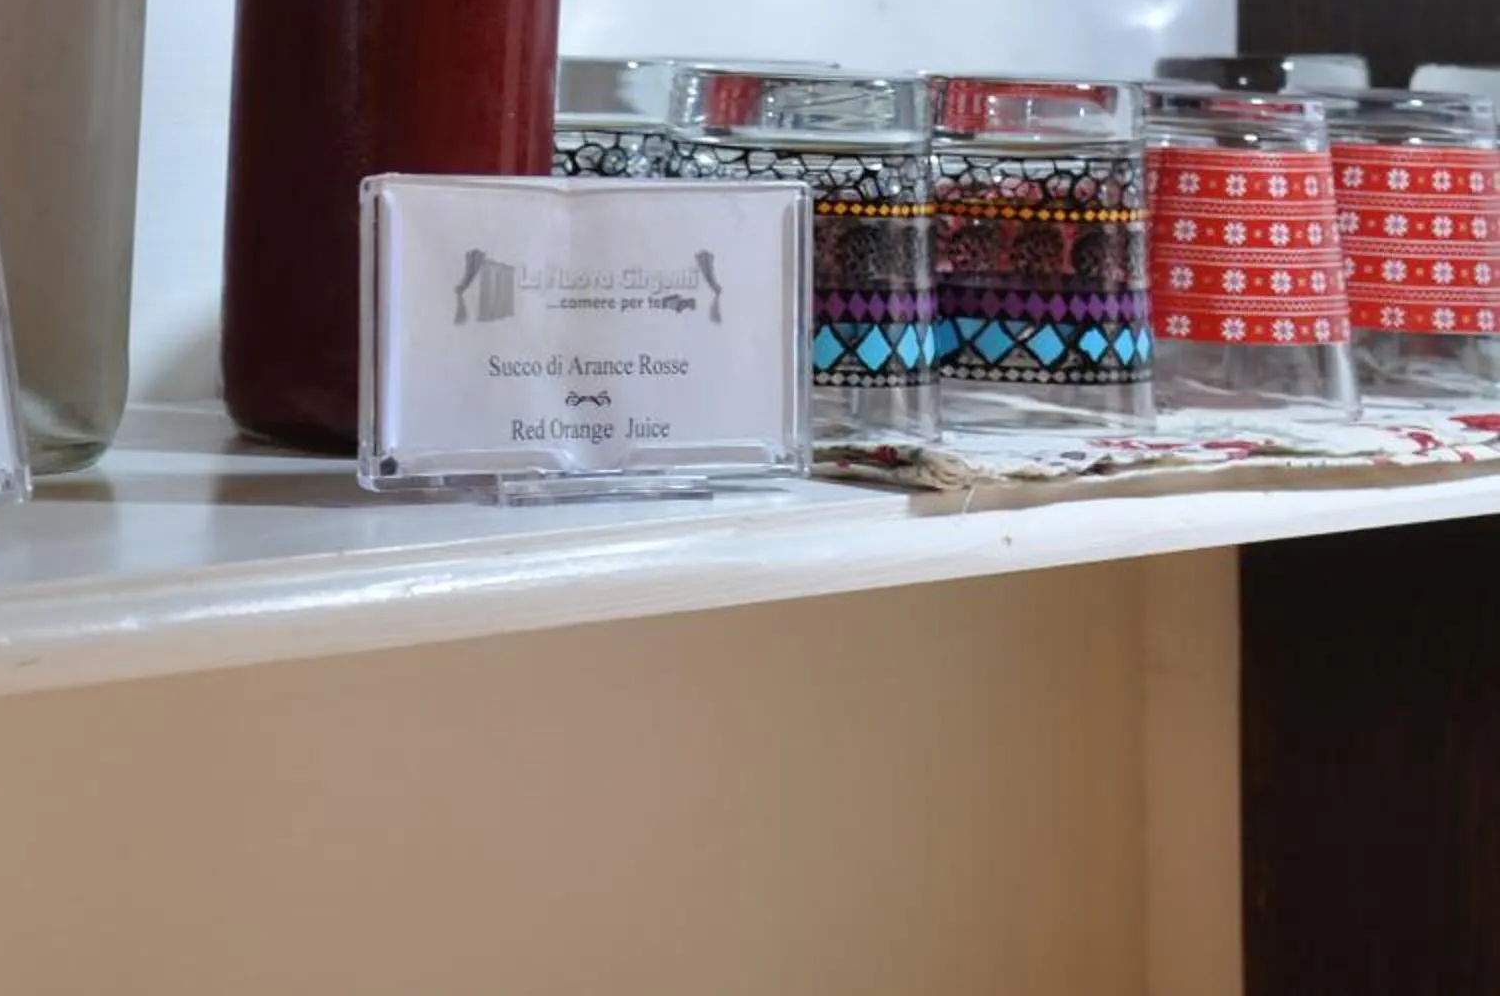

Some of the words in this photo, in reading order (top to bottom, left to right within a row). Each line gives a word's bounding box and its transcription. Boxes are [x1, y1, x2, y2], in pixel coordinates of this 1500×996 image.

[620, 297, 644, 313] per
[488, 354, 542, 378] Succo
[546, 354, 563, 376] di
[567, 355, 634, 376] Arance
[639, 353, 690, 376] Rosse
[511, 419, 545, 441] Red
[550, 418, 614, 445] Orange
[625, 416, 671, 440] Juice
